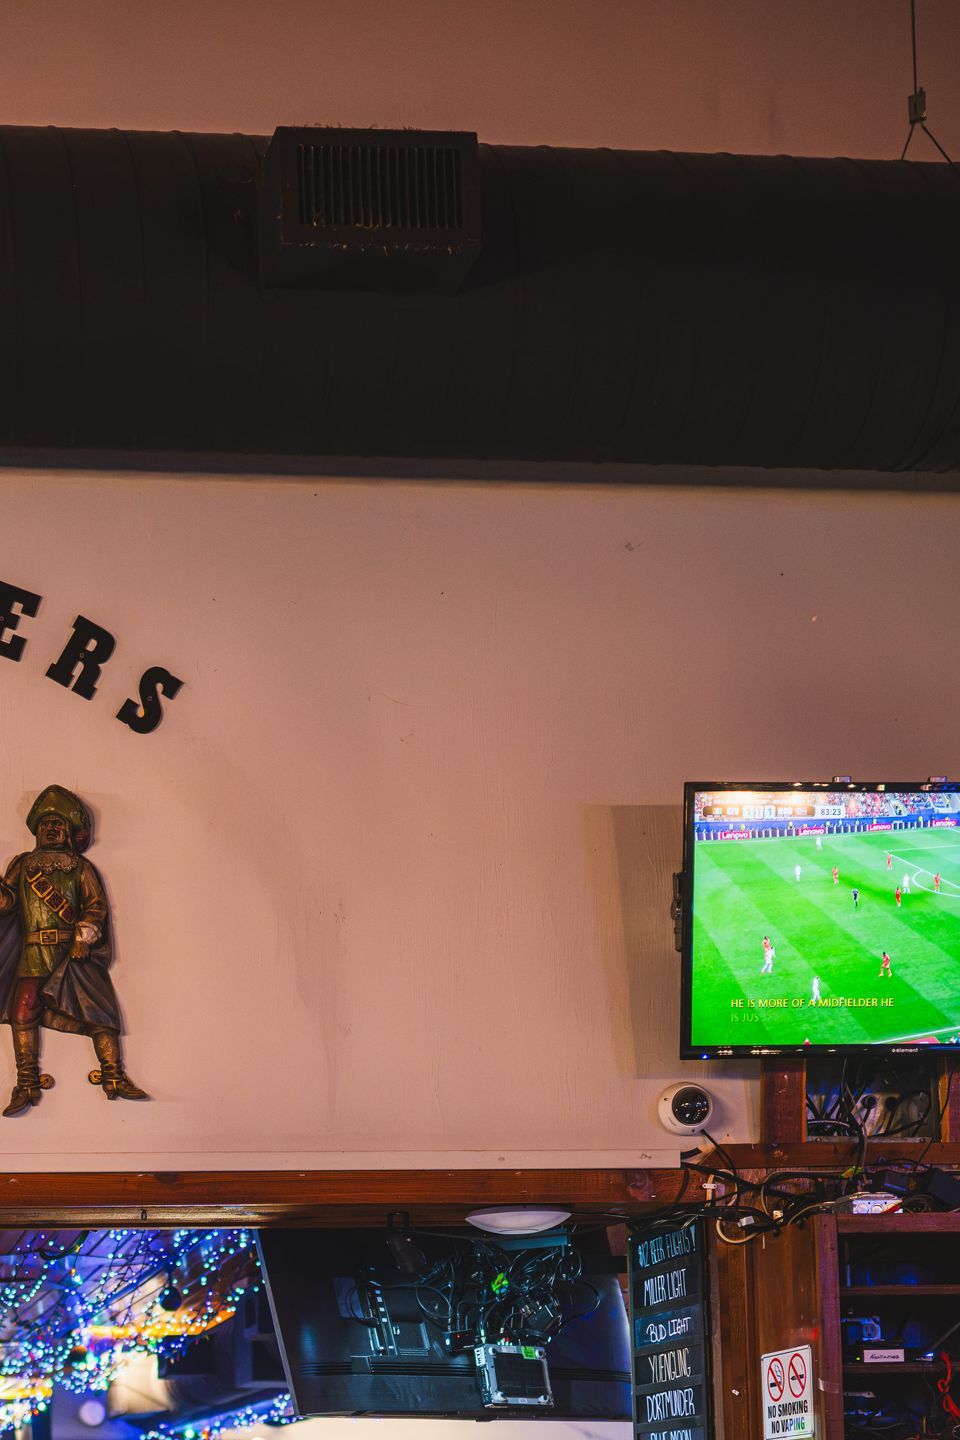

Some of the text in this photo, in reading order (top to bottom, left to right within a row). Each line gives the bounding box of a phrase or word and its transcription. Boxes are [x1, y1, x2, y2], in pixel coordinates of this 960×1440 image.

[820, 808, 842, 816] 83:23
[799, 827, 825, 836] Lenovo
[869, 823, 892, 831] Lenovo
[722, 832, 749, 840] Lenovo
[731, 997, 894, 1008] HE IS MORE OF A MIDFIELDER HE
[731, 1013, 739, 1022] IS
[650, 1237, 666, 1264] BEER
[644, 1268, 687, 1307] MILLER LIGHT
[646, 1316, 692, 1343] BUD LIGHT
[648, 1347, 691, 1384] YUENGLING
[646, 1388, 695, 1423] DORTMUNDER
[768, 1400, 808, 1419] NO SMOKING
[771, 1417, 806, 1434] NO VAPING
